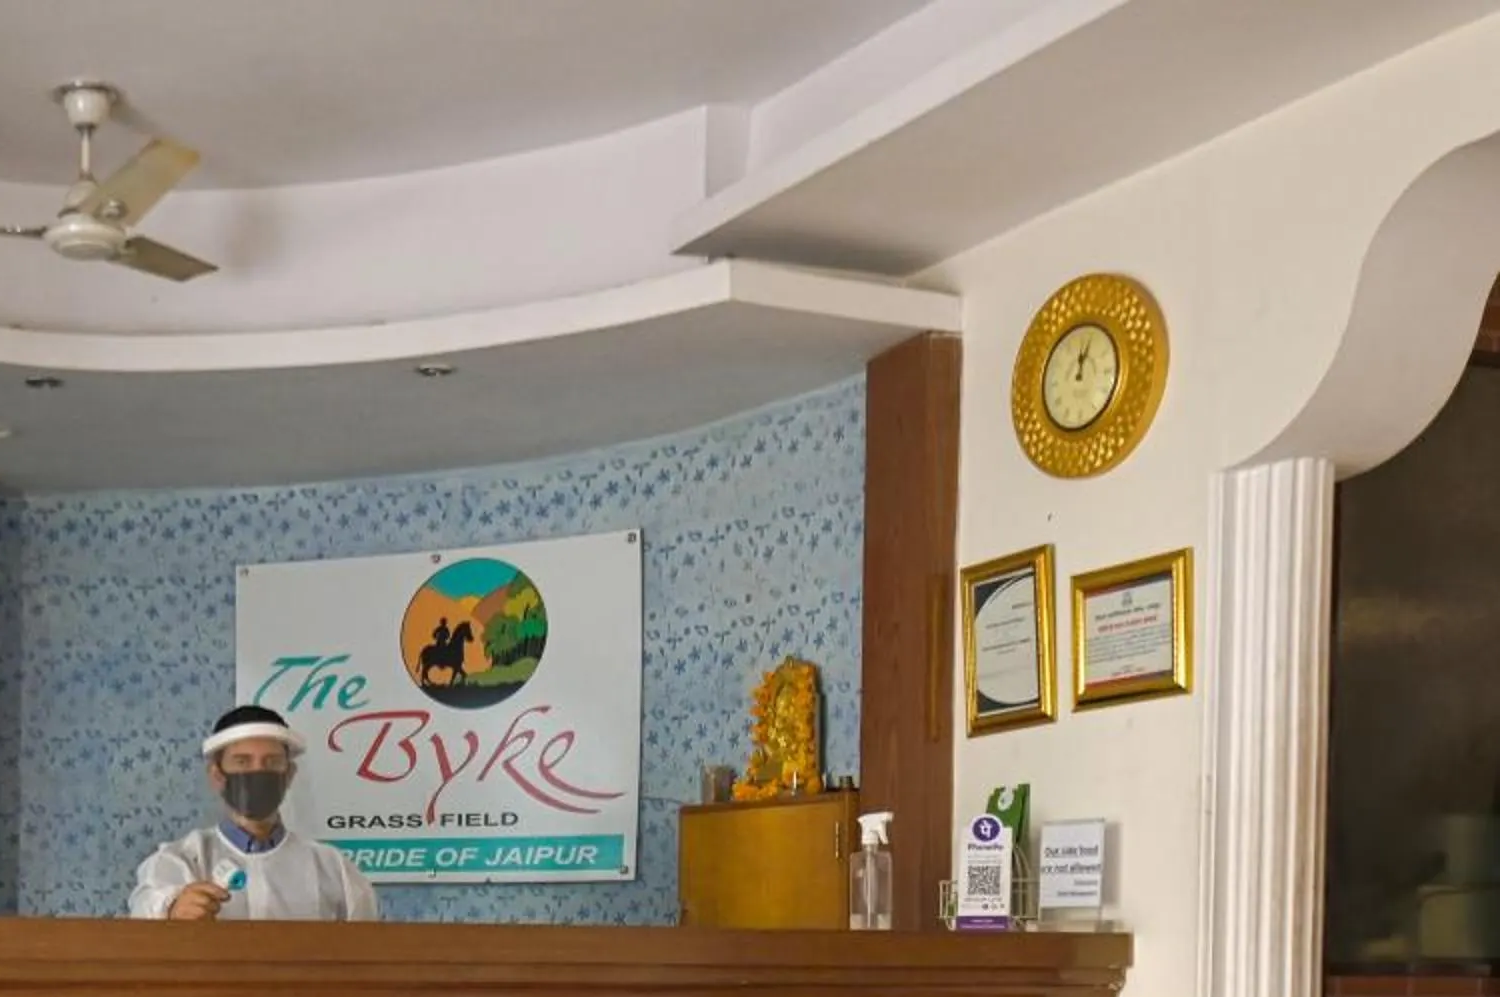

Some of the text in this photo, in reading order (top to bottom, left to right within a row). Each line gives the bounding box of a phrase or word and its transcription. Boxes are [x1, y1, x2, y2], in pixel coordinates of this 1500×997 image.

[254, 654, 372, 712] The
[327, 705, 625, 825] Byke
[327, 812, 519, 829] GRASS FIELD
[436, 847, 477, 867] OF
[485, 845, 598, 866] JAIPUR
